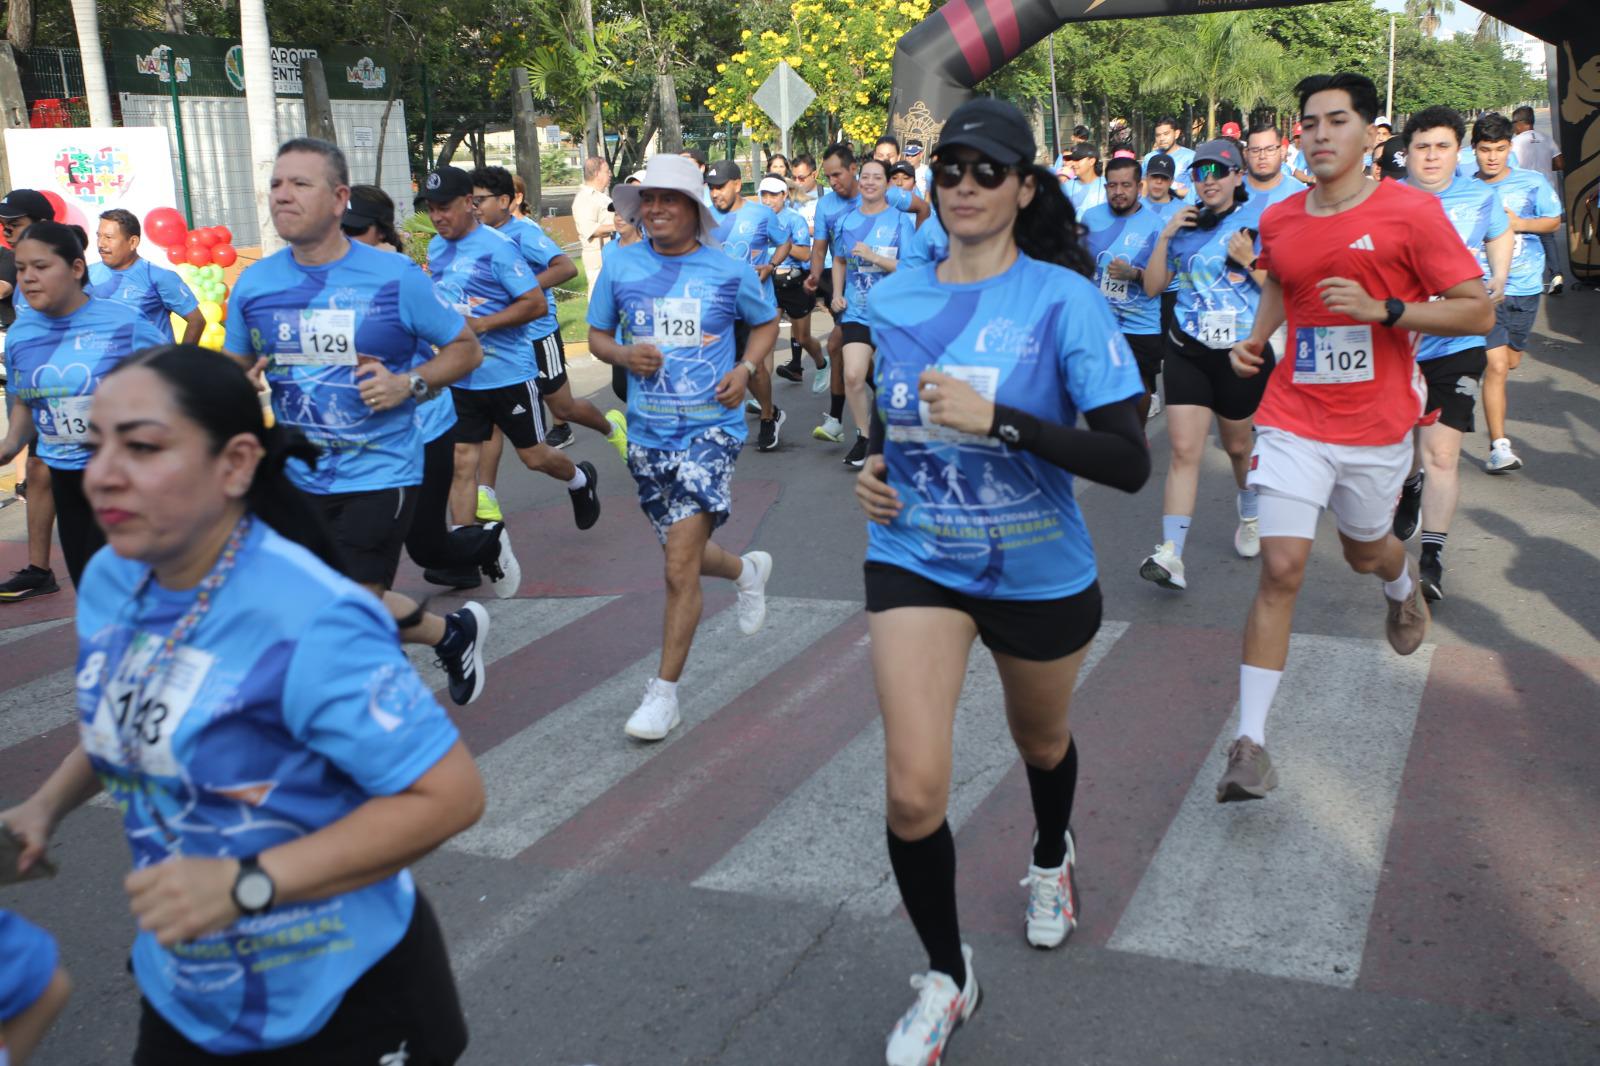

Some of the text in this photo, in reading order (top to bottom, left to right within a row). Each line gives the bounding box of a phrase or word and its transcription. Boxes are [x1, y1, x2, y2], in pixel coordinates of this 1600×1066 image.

[270, 47, 318, 67] ARQUE
[273, 67, 304, 81] ENTR
[1105, 281, 1125, 292] 124
[661, 319, 695, 336] 128
[1201, 328, 1231, 342] 141
[309, 334, 348, 352] 129
[1325, 350, 1367, 371] 102
[62, 418, 87, 435] 13
[955, 511, 1040, 525] INERNACIONAL
[989, 517, 1060, 539] CEREBRAL
